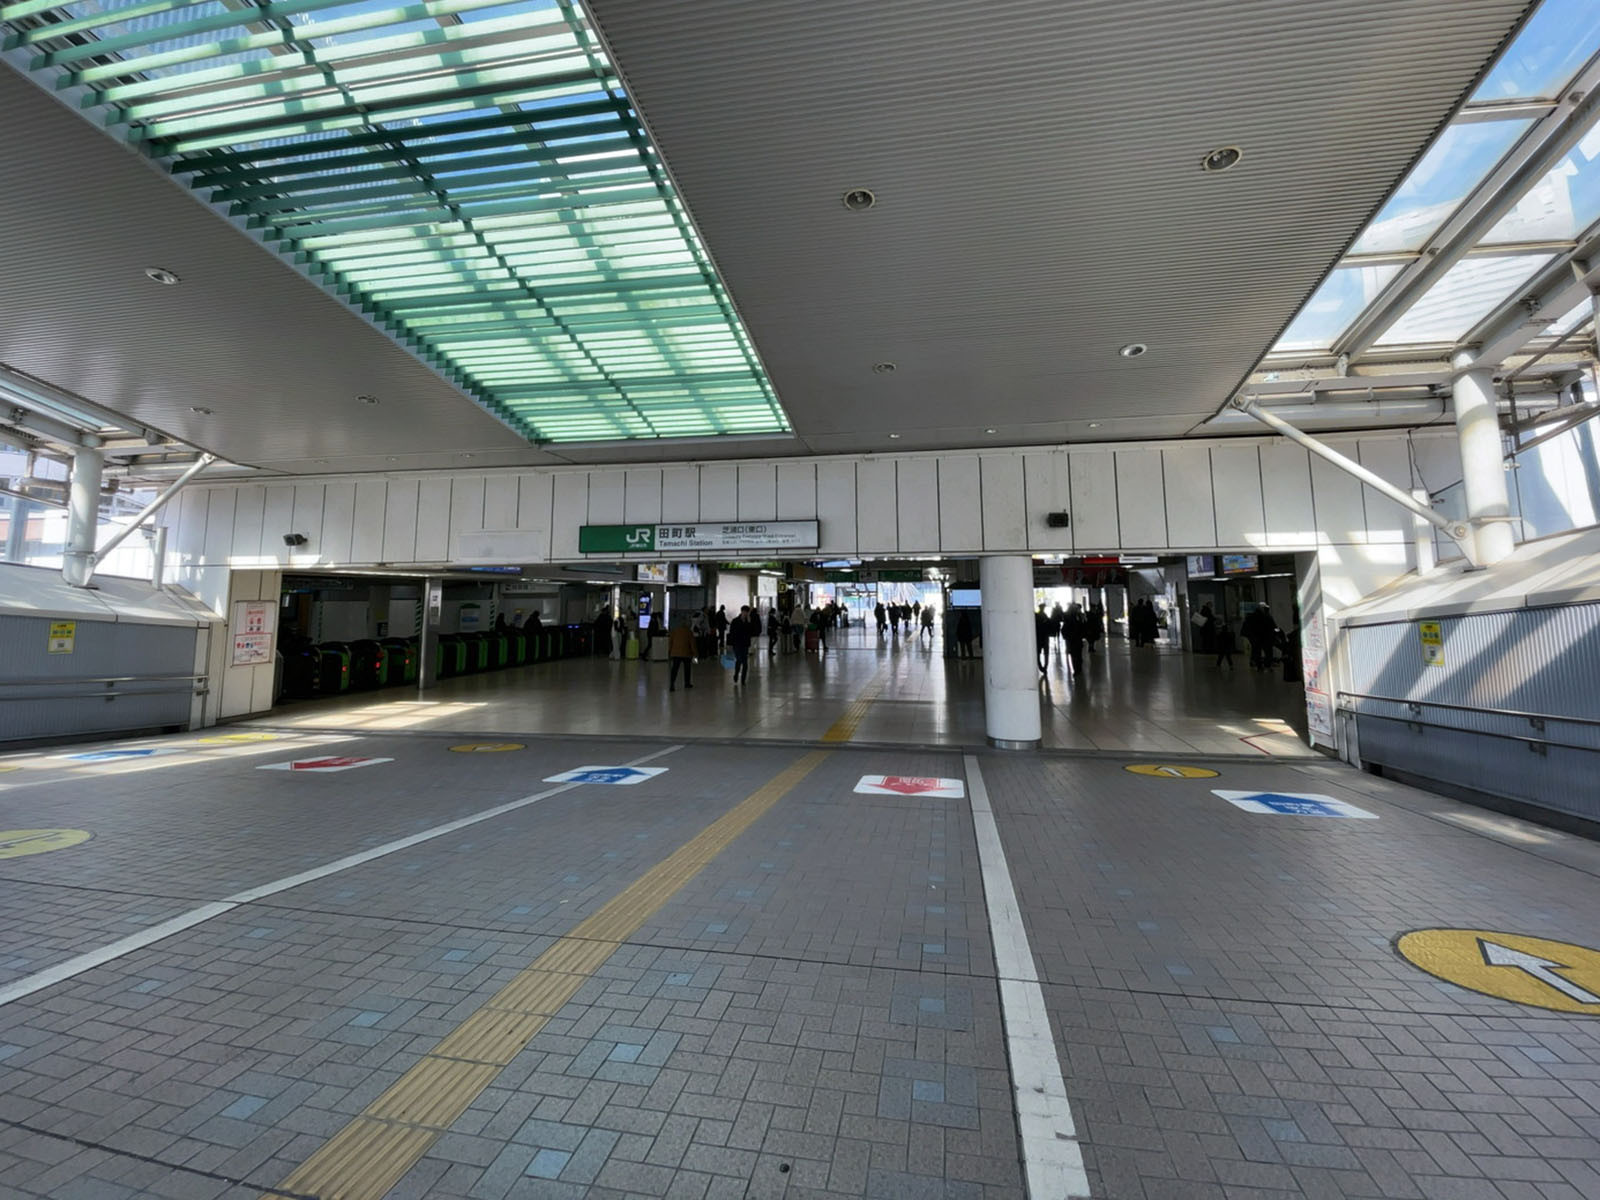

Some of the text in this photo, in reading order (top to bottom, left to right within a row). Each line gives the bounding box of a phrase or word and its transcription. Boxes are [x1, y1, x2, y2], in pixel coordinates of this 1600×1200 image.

[626, 528, 651, 543] JR
[660, 528, 695, 538] 田町駅
[659, 539, 688, 547] Tamachi
[689, 538, 713, 547] Station
